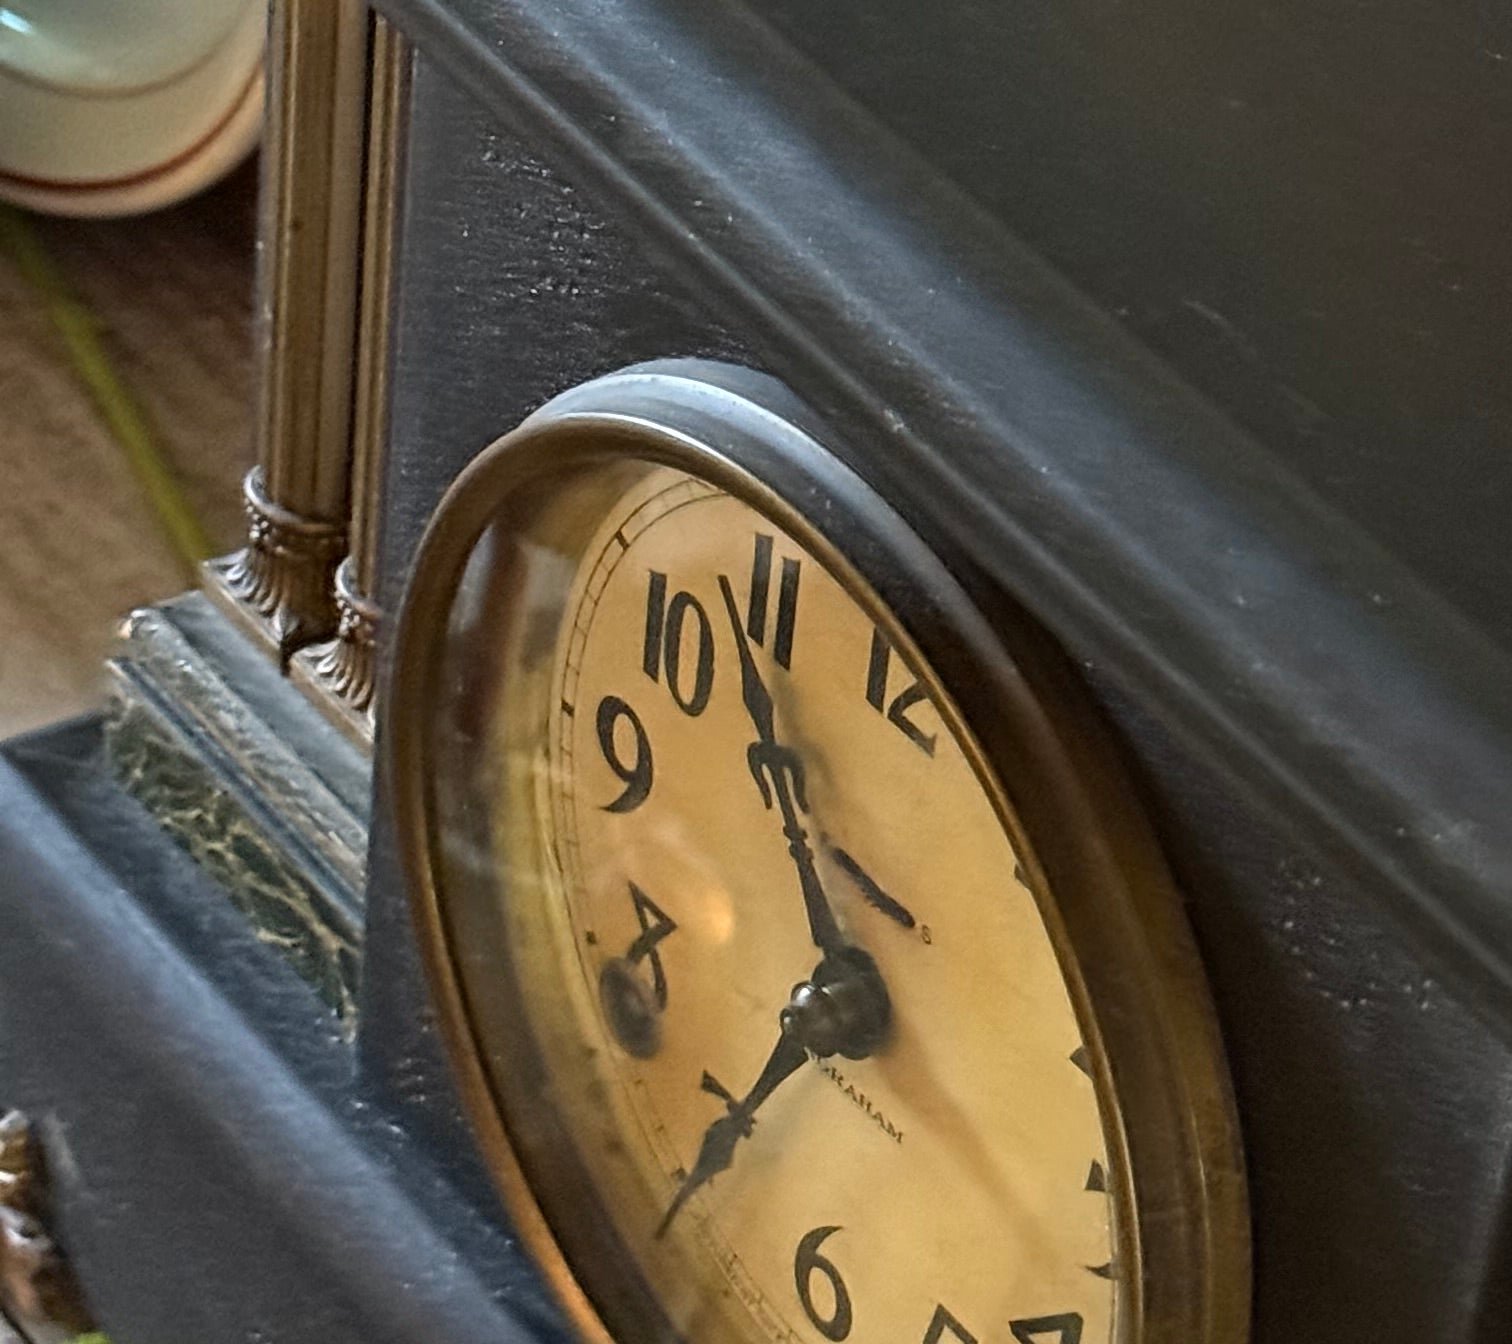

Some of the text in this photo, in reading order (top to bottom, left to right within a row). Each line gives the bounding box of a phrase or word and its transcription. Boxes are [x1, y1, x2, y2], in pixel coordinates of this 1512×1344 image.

[643, 569, 714, 717] 10
[747, 532, 800, 672] 11
[594, 695, 653, 813] 9
[794, 1225, 853, 1343] 6
